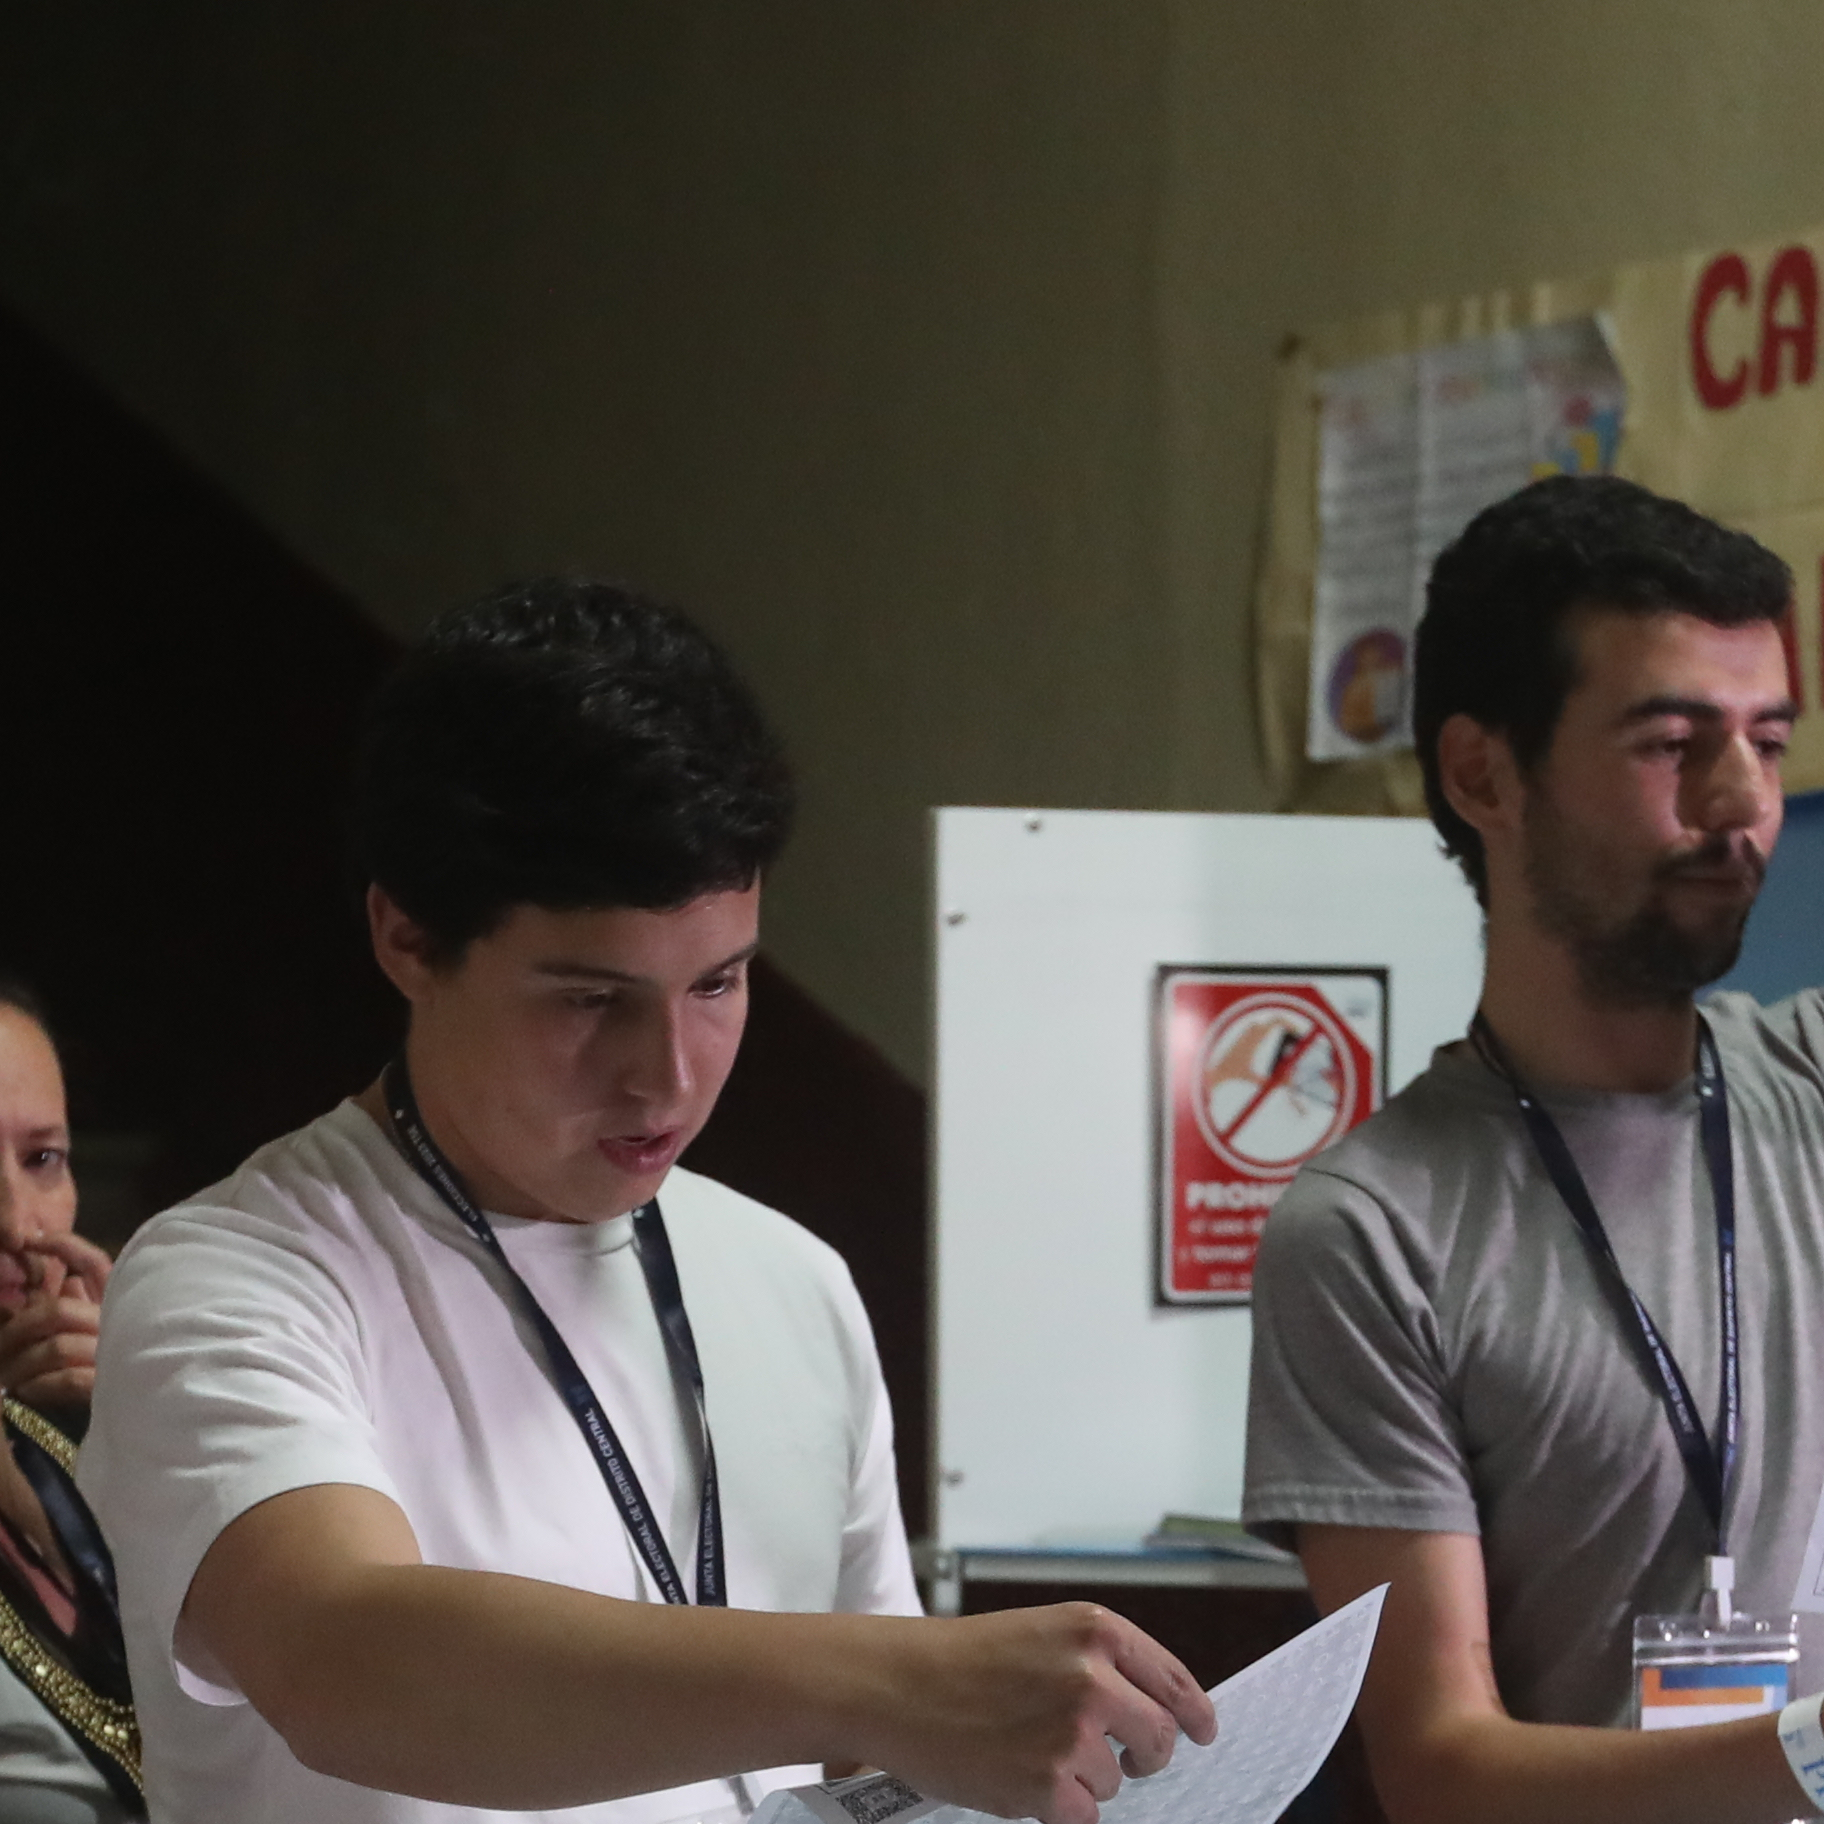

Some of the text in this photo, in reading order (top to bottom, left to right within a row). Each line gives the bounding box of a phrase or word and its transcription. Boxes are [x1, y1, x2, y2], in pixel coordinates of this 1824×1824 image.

[585, 1407, 613, 1457] CENTRAL
[607, 1457, 637, 1506] DISTRITO
[628, 1504, 644, 1522] DE
